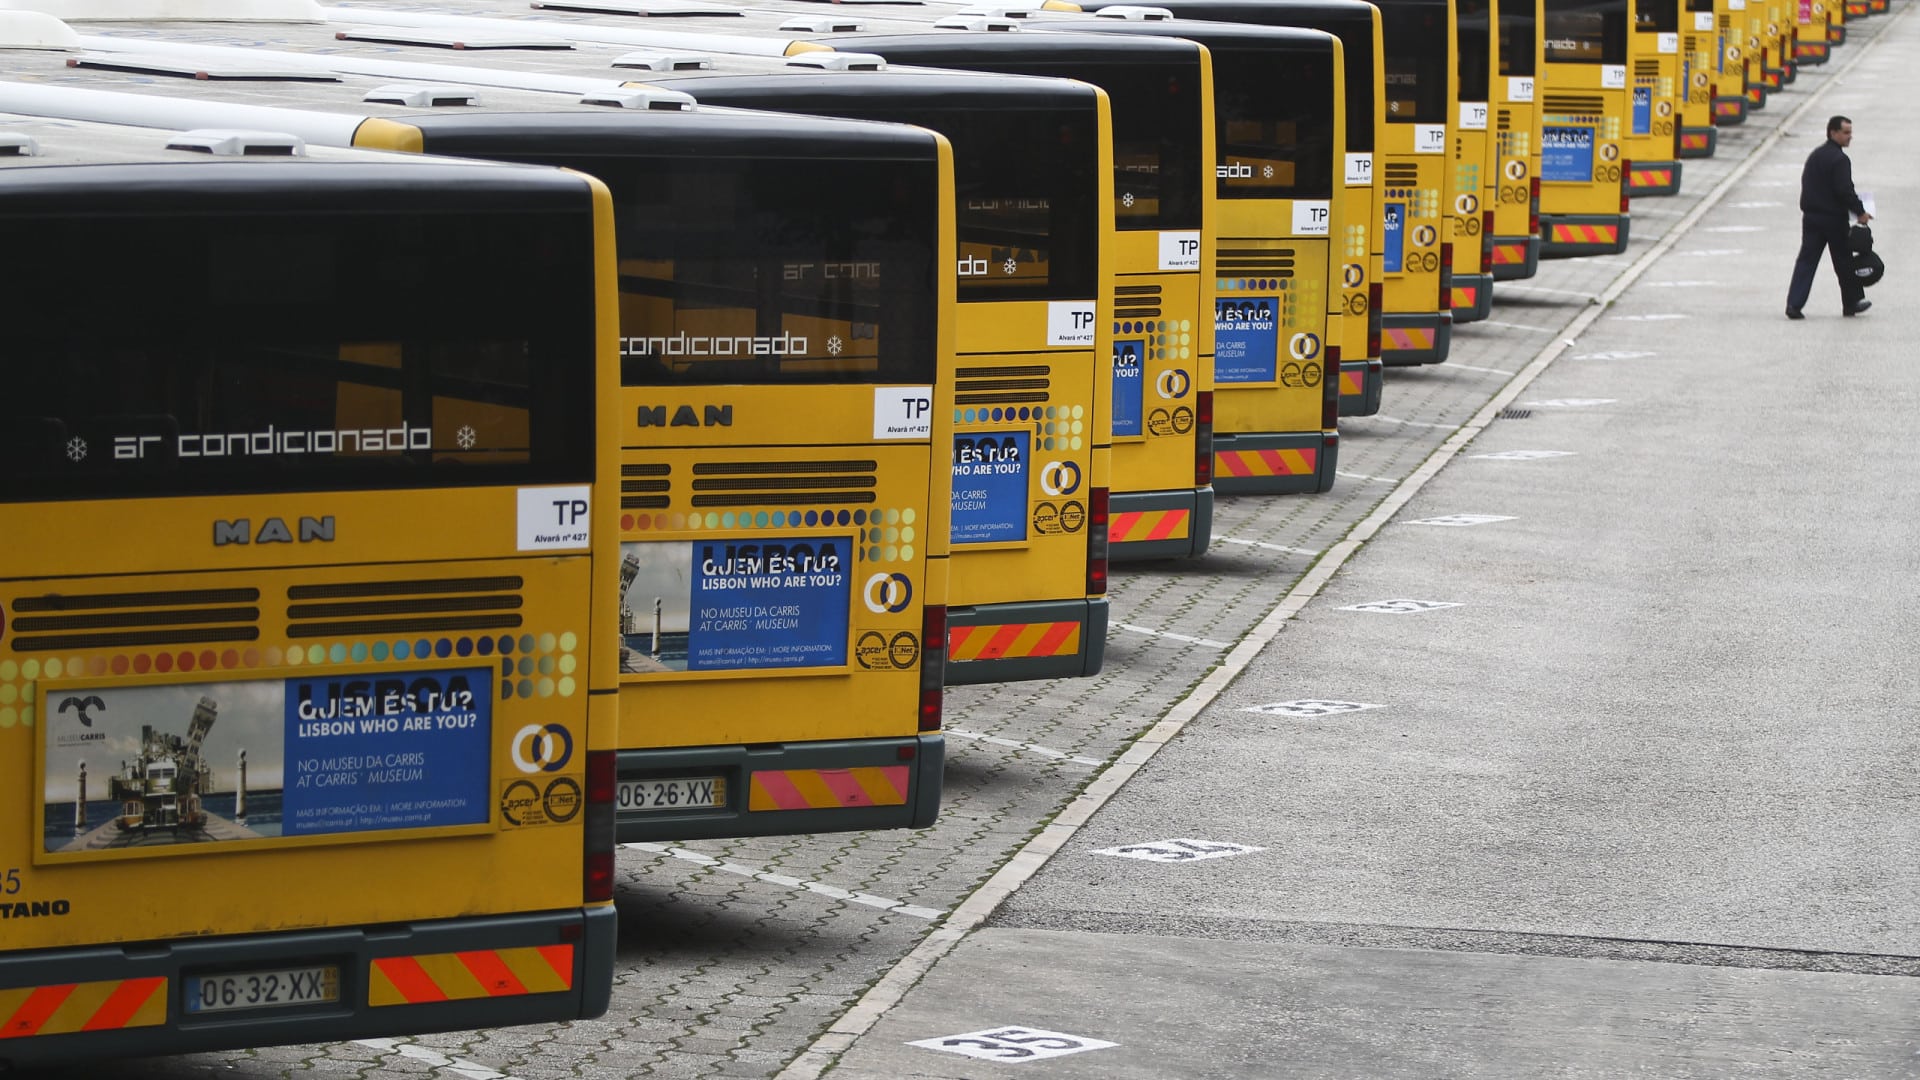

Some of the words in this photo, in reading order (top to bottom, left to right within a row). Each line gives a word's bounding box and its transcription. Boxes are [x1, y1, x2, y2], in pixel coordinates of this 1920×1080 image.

[1521, 82, 1533, 92] TP
[1473, 108, 1486, 119] TP
[1429, 130, 1443, 142] TP
[1355, 160, 1371, 172] TP
[1310, 208, 1328, 222] TP
[1178, 240, 1198, 255] TP
[957, 254, 988, 276] do
[1071, 311, 1094, 329] TP
[1235, 322, 1250, 330] ARE
[1252, 321, 1273, 330] YOU?
[1115, 368, 1139, 377] YOU?
[638, 405, 732, 427] MAN
[902, 398, 929, 419] TP
[114, 436, 161, 459] ar
[178, 420, 431, 457] condicionado
[989, 447, 1019, 462] TU?
[973, 465, 992, 475] ARE
[994, 463, 1021, 474] YOU?
[961, 490, 987, 500] CARRIS
[553, 500, 587, 525] TP
[214, 515, 335, 546] MAN
[535, 533, 560, 543] Alvará
[572, 533, 587, 541] 427
[769, 553, 796, 574] ÉS
[803, 555, 839, 573] TU?
[702, 577, 747, 590] LISBON
[750, 576, 781, 589] WHO
[784, 575, 806, 588] ARE
[809, 574, 842, 587] YOU?
[701, 607, 717, 619] NO
[720, 606, 752, 618] MUSEU
[754, 606, 767, 617] DA
[769, 605, 800, 617] CARRIS
[699, 620, 711, 632] AT
[755, 618, 799, 630] MUSEUM
[384, 689, 417, 716] ÉS
[428, 690, 473, 713] TU?
[1262, 701, 1361, 715] 33
[299, 721, 355, 738] LISBON
[359, 718, 399, 734] WHO
[403, 716, 432, 732] ARE
[435, 713, 477, 729] YOU?
[298, 759, 319, 773] NO
[322, 756, 363, 771] MUSEU
[366, 755, 383, 769] DA
[385, 752, 425, 767] CARRIS
[296, 775, 312, 788] AT
[368, 768, 423, 784] MUSEUM
[1118, 838, 1241, 861] 34
[942, 1029, 1084, 1058] 35
